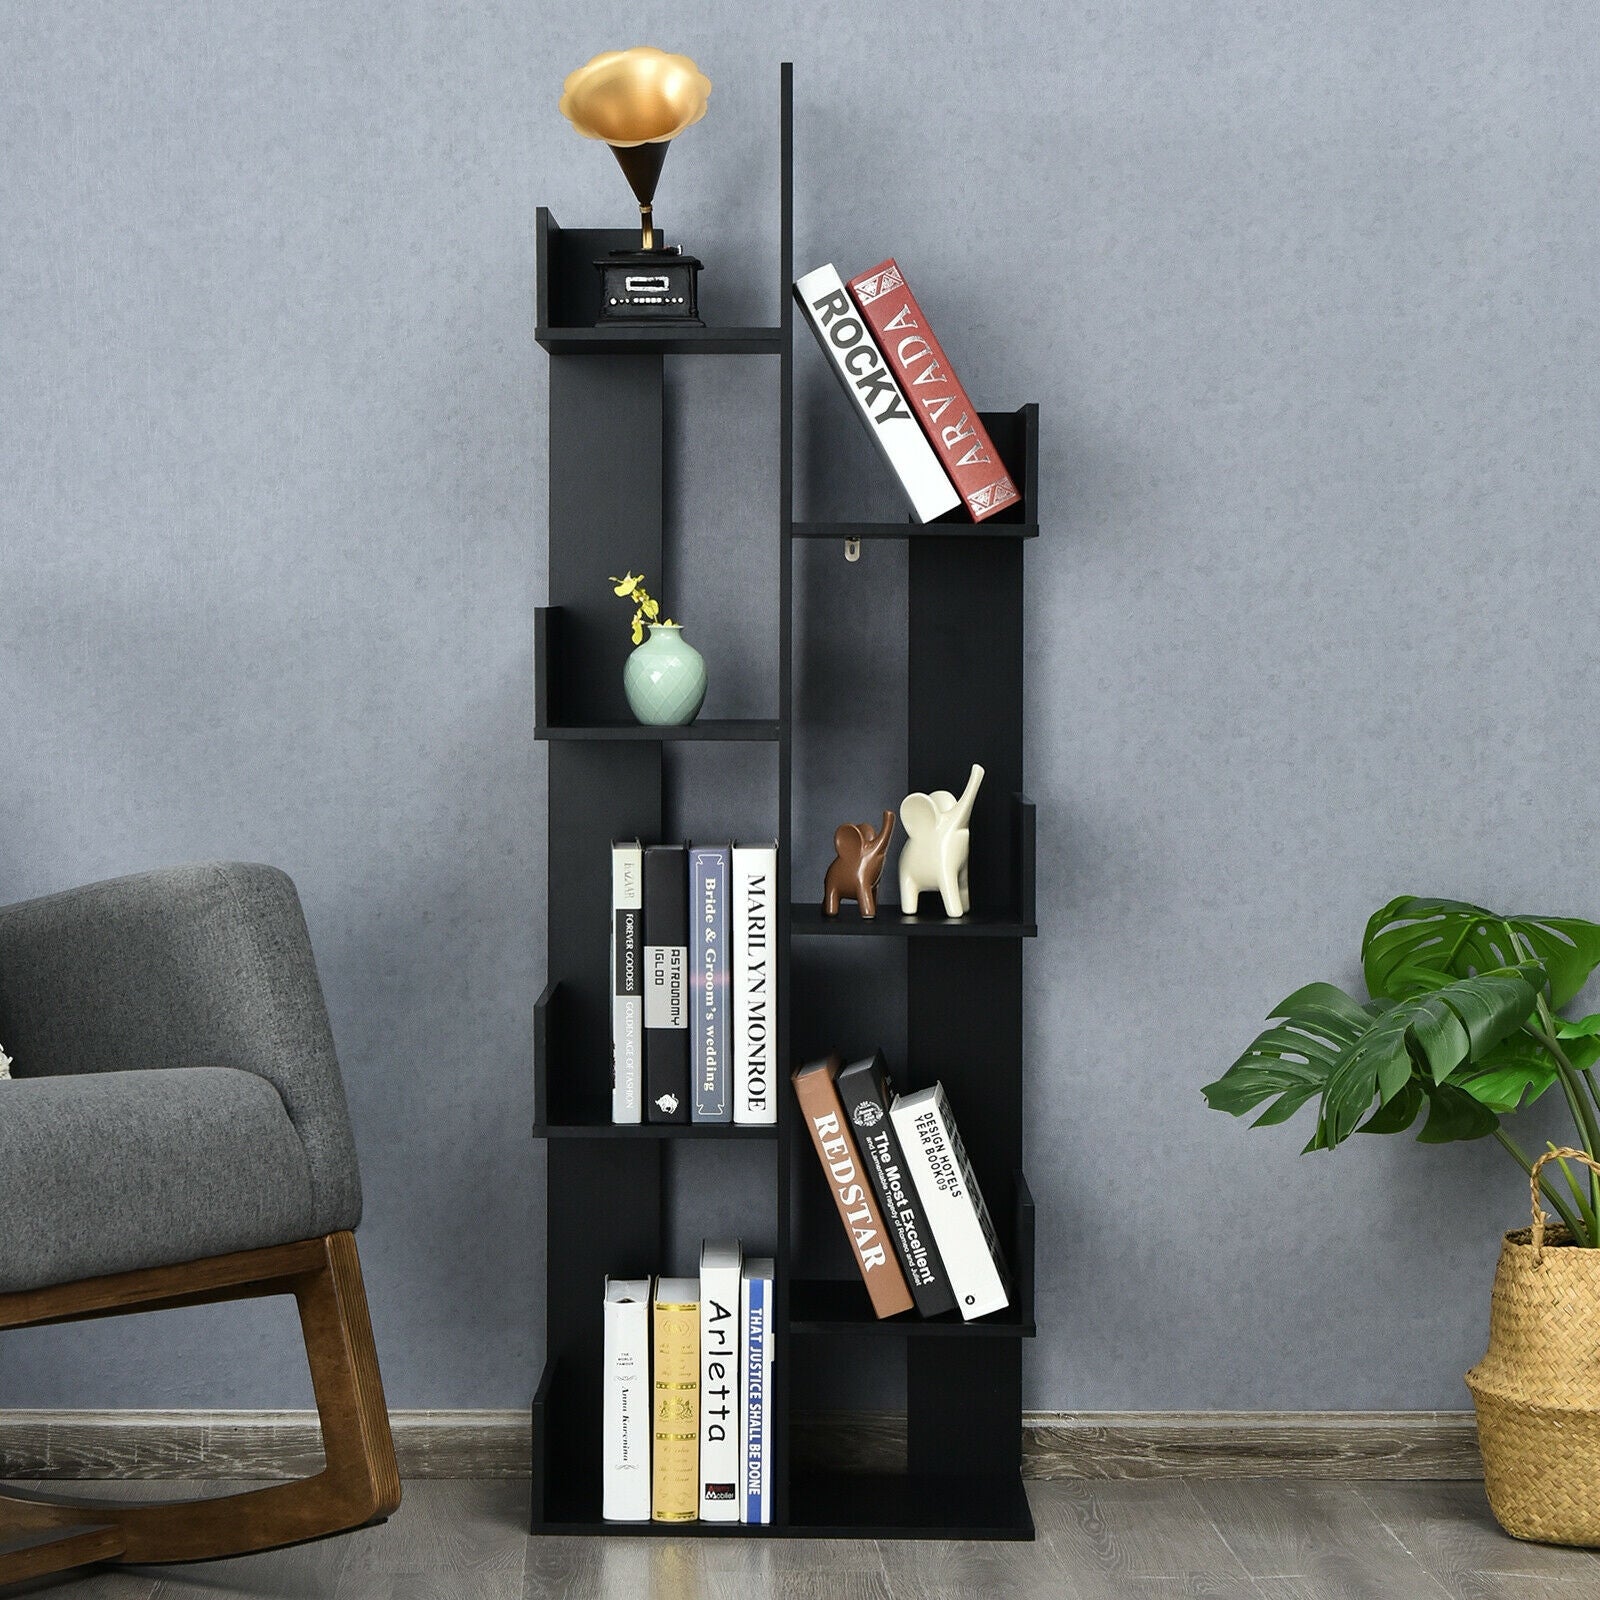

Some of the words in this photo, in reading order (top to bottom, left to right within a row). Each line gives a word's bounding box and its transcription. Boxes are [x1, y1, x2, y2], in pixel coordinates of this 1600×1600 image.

[813, 288, 911, 424] ROCKY
[883, 304, 991, 466] ARVADA
[705, 878, 716, 923] Bride
[626, 914, 634, 950] FOREVER
[705, 928, 717, 943] &
[747, 874, 766, 994] MARILYN
[626, 951, 634, 991] GODDESS
[655, 949, 664, 985] IGLOO
[670, 949, 680, 1025] ASTRONOMY
[625, 1001, 634, 1038] GOLDEN
[625, 1039, 634, 1056] AGE
[625, 1057, 634, 1070] OF
[704, 1025, 717, 1091] wedding
[747, 1000, 767, 1112] MONROE
[625, 1072, 634, 1109] FASHION
[866, 1136, 875, 1150] and
[914, 1115, 931, 1144] YEAR
[871, 1150, 888, 1190] Lamentable
[924, 1112, 946, 1153] DESIGN
[939, 1155, 962, 1198] HOTELS
[813, 1111, 886, 1272] REDSTAR
[874, 1131, 891, 1163] The
[885, 1166, 909, 1207] Most
[900, 1209, 935, 1284] Excellent
[885, 1190, 898, 1218] Tragedy
[895, 1219, 902, 1227] of
[898, 1227, 910, 1252] Romeo
[906, 1254, 916, 1267] and
[911, 1268, 922, 1286] Juliet
[750, 1308, 762, 1342] THAT
[708, 1300, 733, 1441] Arletta
[749, 1346, 762, 1400] JUSTICE
[622, 1386, 630, 1412] Anna
[622, 1415, 630, 1461] Karenina
[749, 1403, 762, 1440] SHALL
[749, 1444, 761, 1458] BE
[748, 1461, 761, 1495] DONE
